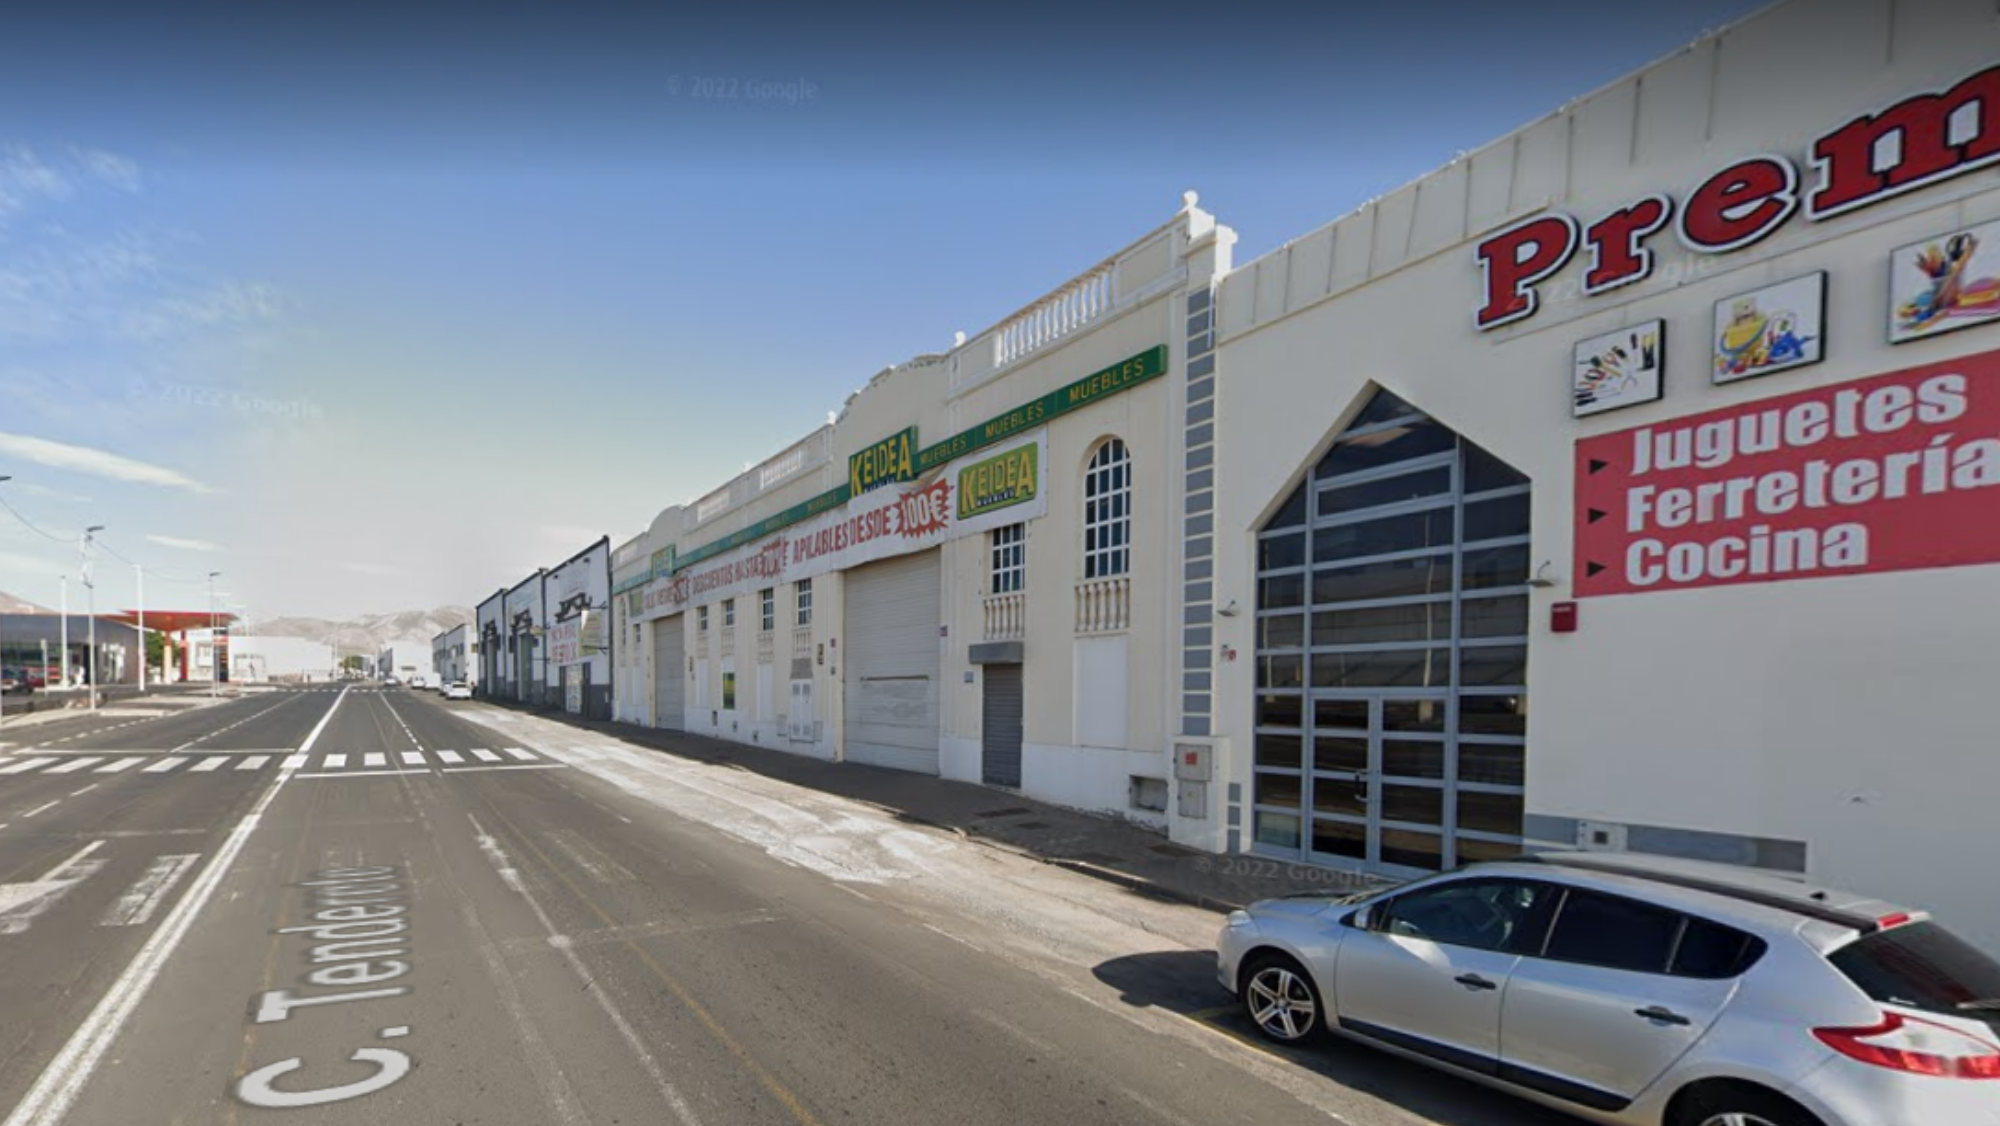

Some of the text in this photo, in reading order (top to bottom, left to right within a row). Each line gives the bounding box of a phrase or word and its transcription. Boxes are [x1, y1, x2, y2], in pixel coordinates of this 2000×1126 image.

[1069, 357, 1144, 403] MUEBLES
[920, 435, 967, 464] MUEBLES
[985, 401, 1044, 438] MUEBLES
[1630, 373, 1967, 477] Juguetes
[850, 433, 912, 499] KEIDEA
[961, 451, 1035, 514] KEIDEA
[1627, 433, 2000, 532] Ferretería
[793, 520, 848, 564] APILABLES
[850, 505, 892, 545] DESDE
[901, 488, 944, 532] 100€
[1626, 522, 1868, 586] Cocina
